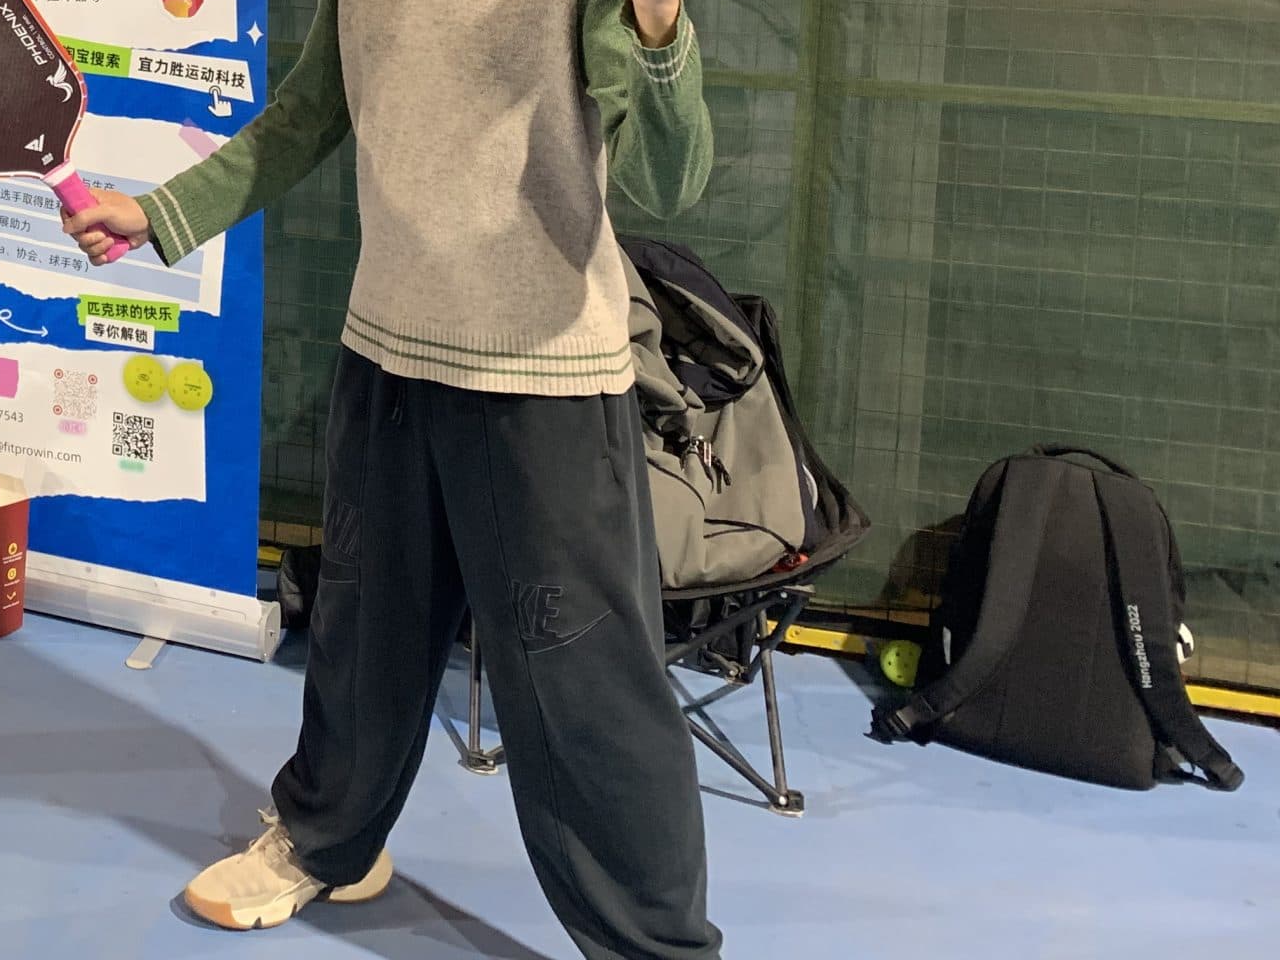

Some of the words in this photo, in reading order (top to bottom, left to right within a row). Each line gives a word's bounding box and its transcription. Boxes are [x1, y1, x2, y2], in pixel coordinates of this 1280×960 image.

[36, 34, 55, 60] CONTROL
[138, 56, 246, 89] 宜力胜运动科技
[87, 301, 173, 321] 匹克球的快乐
[92, 323, 149, 344] 等你解锁
[1126, 604, 1142, 632] 2022
[1132, 634, 1153, 689] Hangzhou
